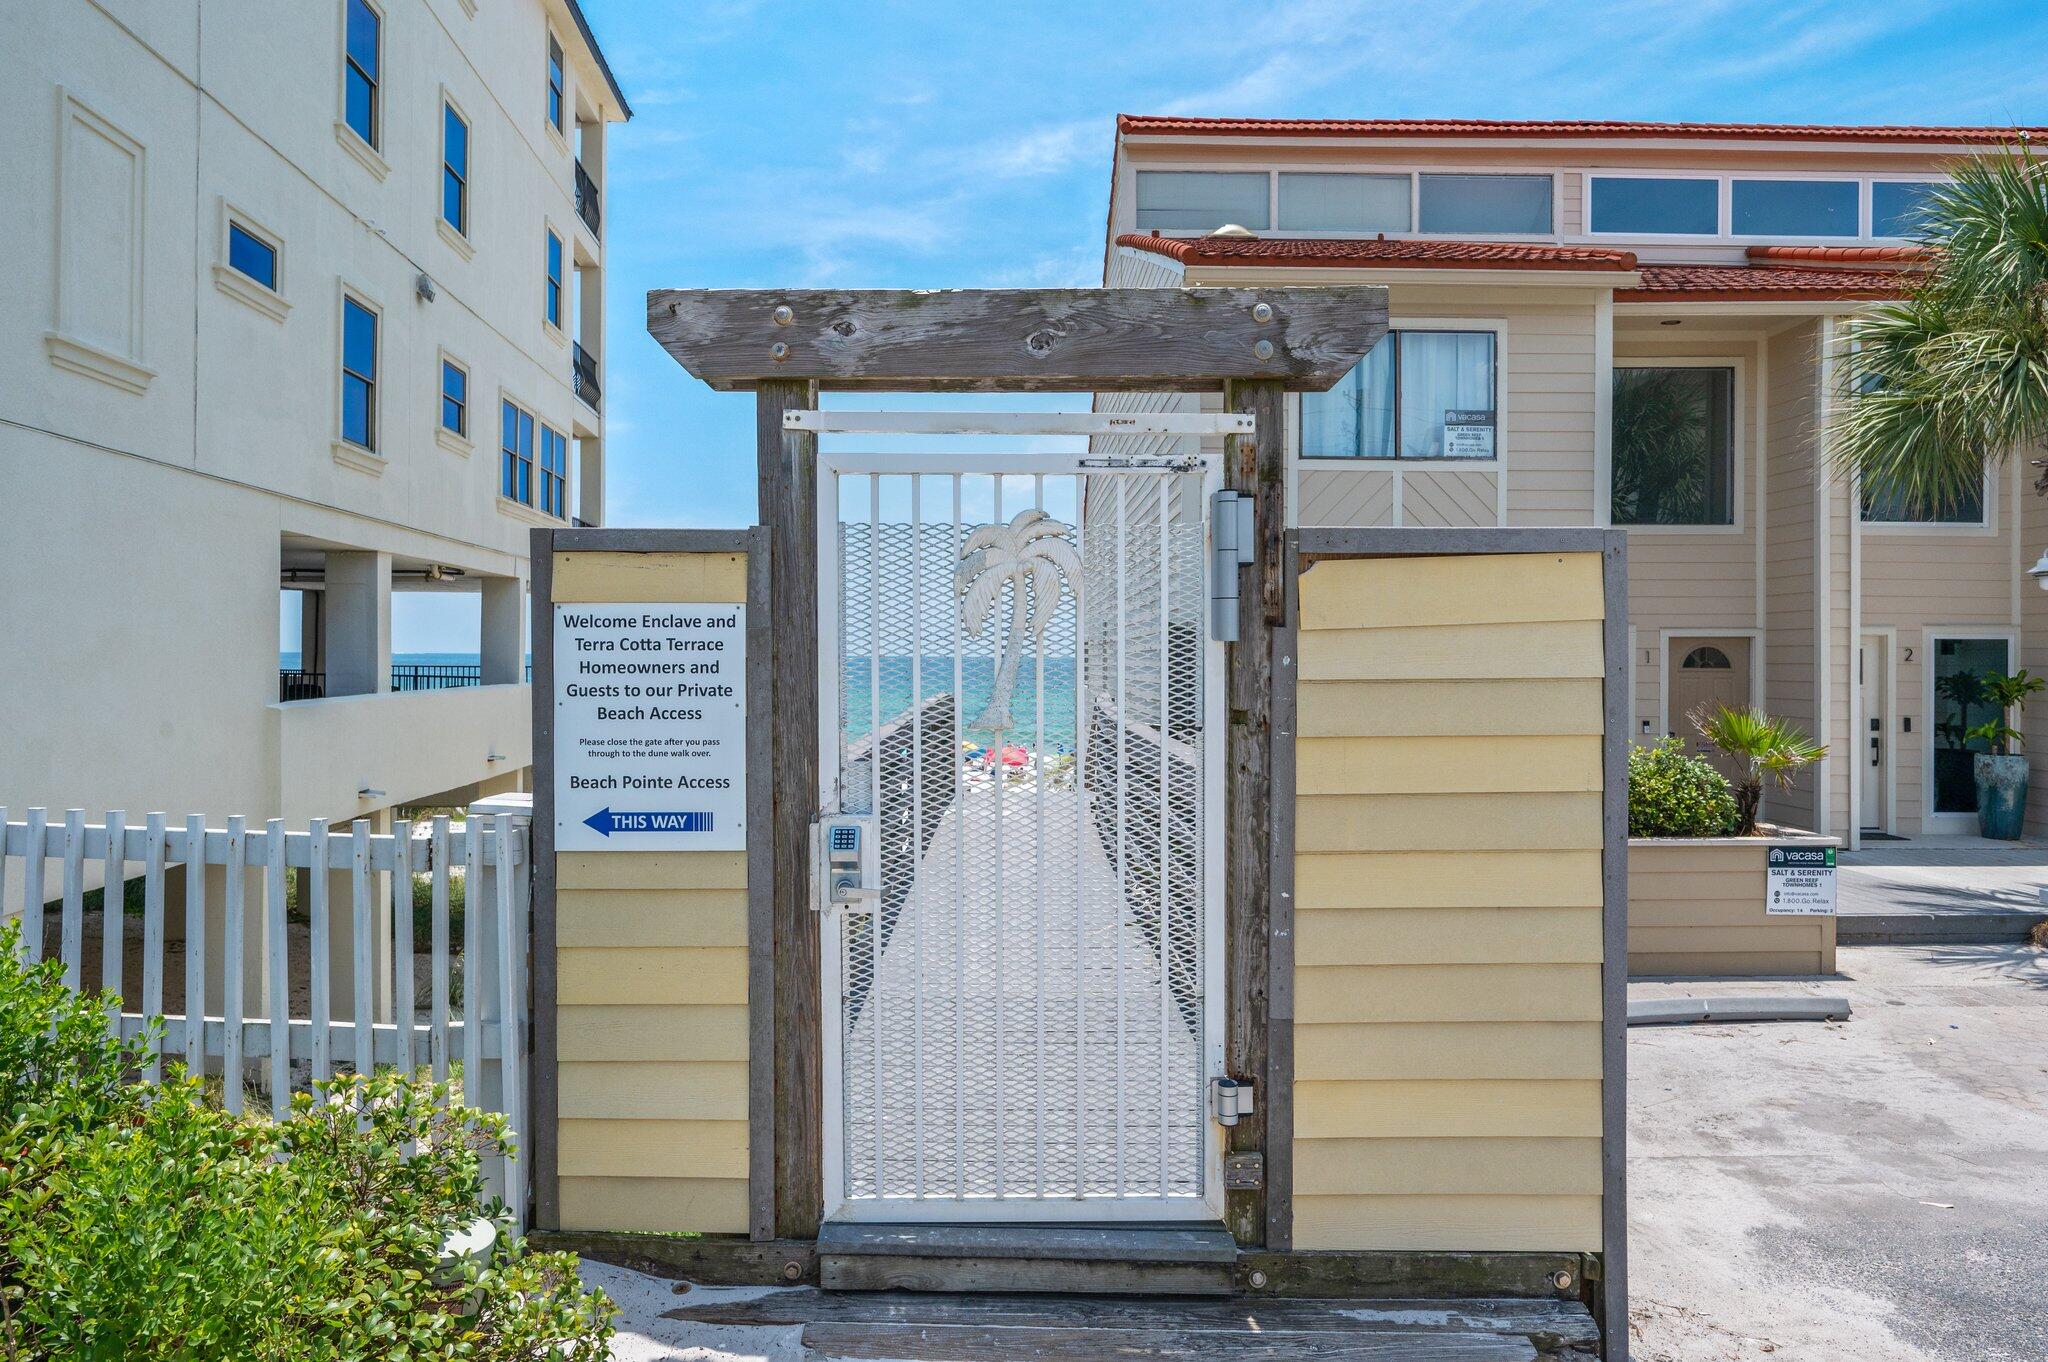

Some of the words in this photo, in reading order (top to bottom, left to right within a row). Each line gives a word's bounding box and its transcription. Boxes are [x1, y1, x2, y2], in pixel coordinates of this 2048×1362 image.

[563, 614, 637, 629] Welcome
[642, 614, 702, 628] Enclave
[706, 614, 736, 628] and
[575, 637, 615, 651] Terra
[619, 638, 662, 651] Cotta
[666, 637, 724, 651] Terrace
[1903, 648, 1914, 662] 2
[579, 660, 686, 675] Homeowners
[690, 660, 720, 674] and
[566, 683, 620, 698] Guests
[624, 684, 641, 697] to
[645, 686, 673, 697] our
[677, 683, 733, 697] Private
[597, 706, 645, 720] Beach
[649, 706, 702, 720] Access
[579, 738, 605, 746] Please
[607, 738, 628, 746] close
[629, 738, 643, 746] the
[645, 738, 662, 748] gate
[664, 737, 684, 746] after
[685, 739, 701, 748] you
[702, 739, 721, 748] pass
[588, 749, 620, 758] through
[632, 749, 646, 757] the
[648, 749, 669, 757] dune
[670, 749, 690, 757] walk
[570, 774, 617, 789] Beach
[622, 774, 673, 789] Pointe
[677, 775, 730, 789] Access
[611, 815, 647, 829] THIS
[651, 815, 688, 829] WAY
[1786, 852, 1824, 860] vacasa
